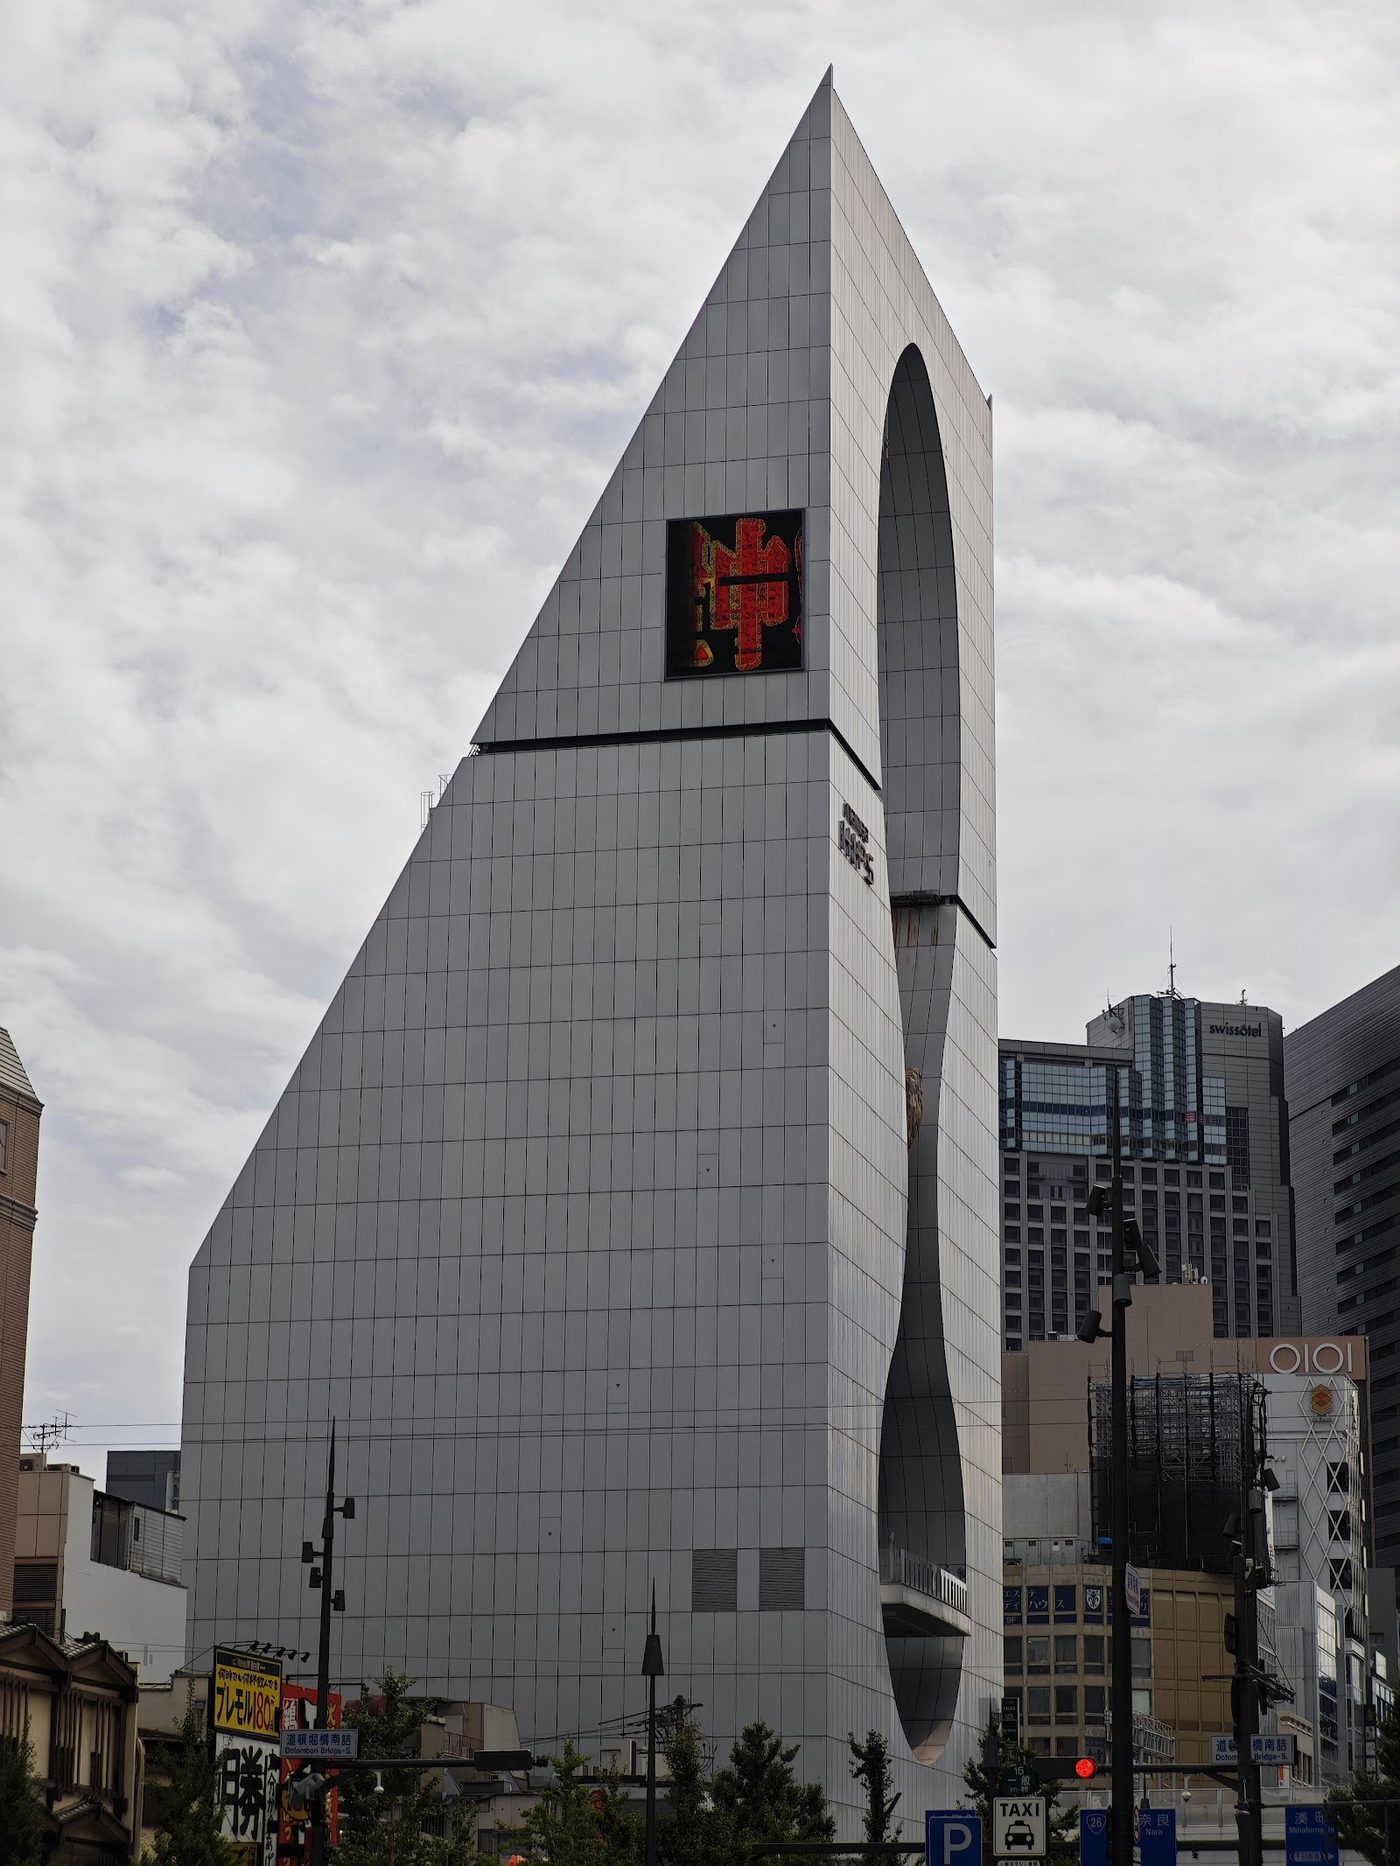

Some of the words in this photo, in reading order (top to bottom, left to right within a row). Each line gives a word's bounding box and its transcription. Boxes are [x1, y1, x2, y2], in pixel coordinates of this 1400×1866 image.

[286, 1733, 352, 1746] 道頓堀橋南詰
[1000, 1803, 1040, 1817] TAXI
[1090, 1817, 1103, 1828] 26
[1139, 1814, 1170, 1827] 奈良
[1145, 1828, 1163, 1837] Nara
[944, 1823, 973, 1865] P
